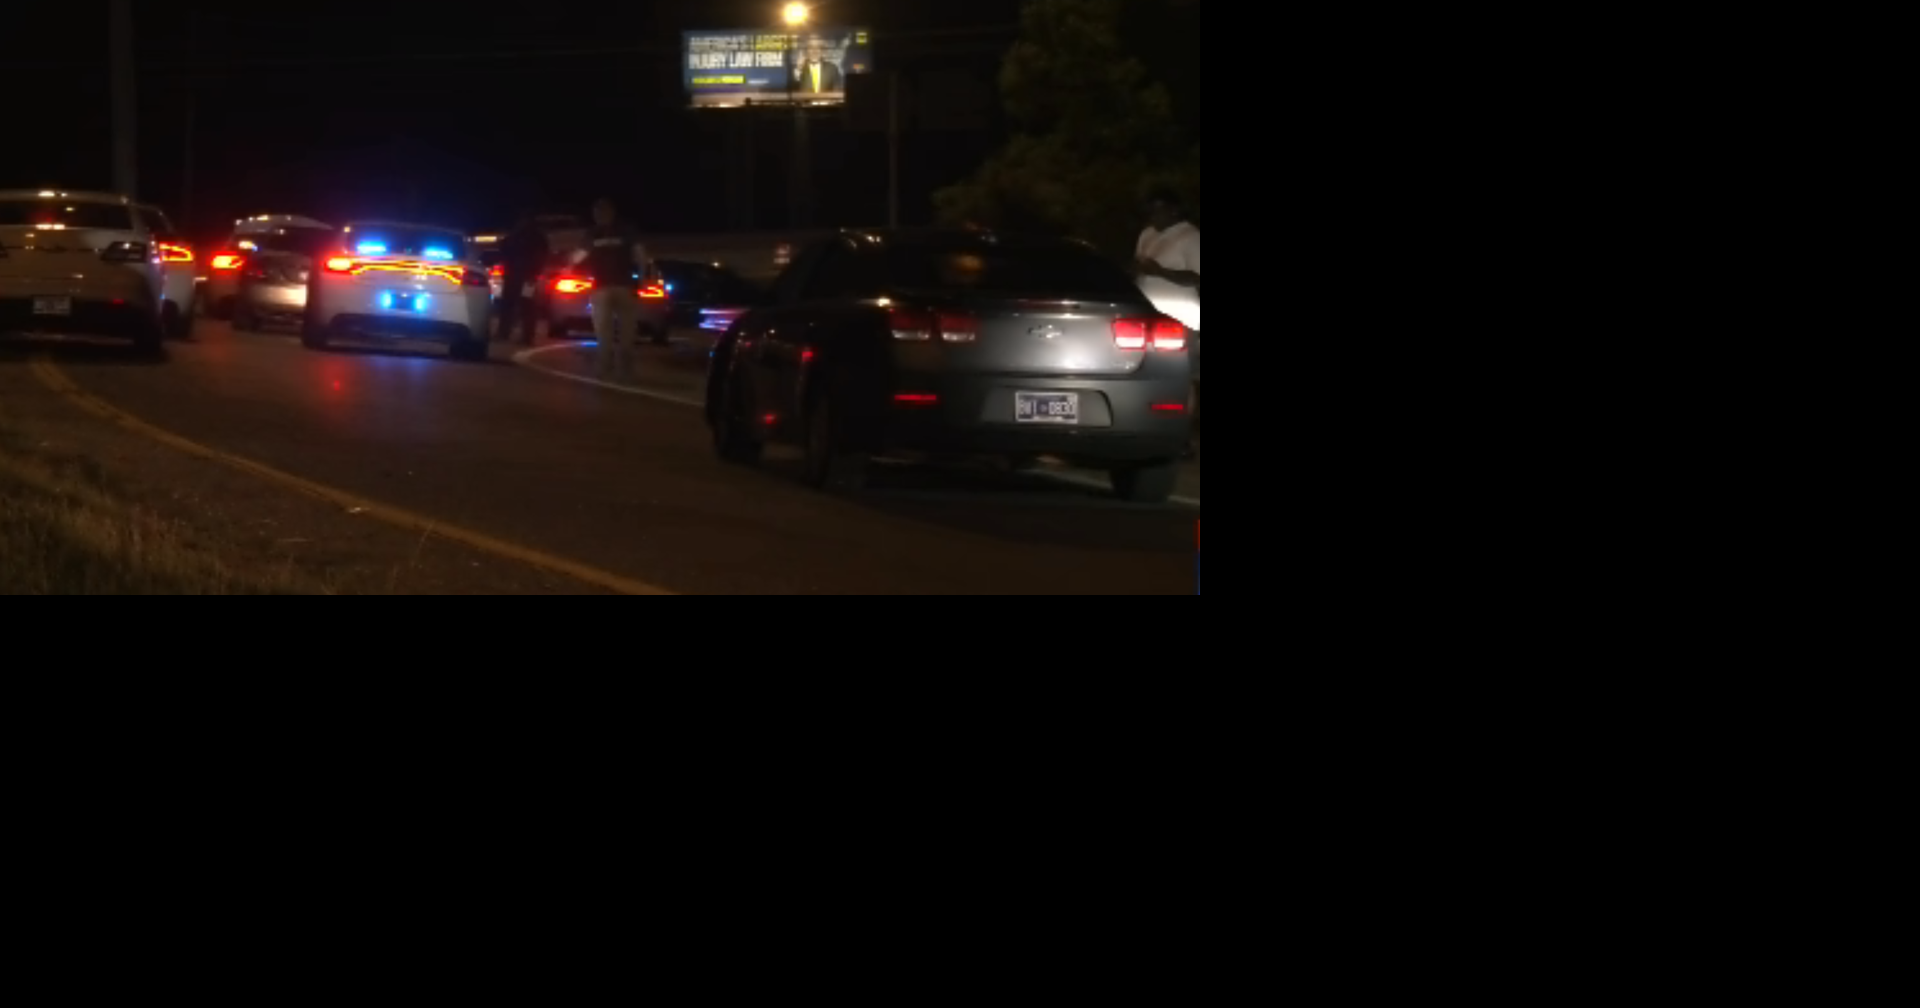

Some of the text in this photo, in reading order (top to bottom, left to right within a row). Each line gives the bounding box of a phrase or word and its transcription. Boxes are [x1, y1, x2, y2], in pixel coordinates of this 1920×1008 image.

[688, 50, 784, 69] INJURY LAW FIRM
